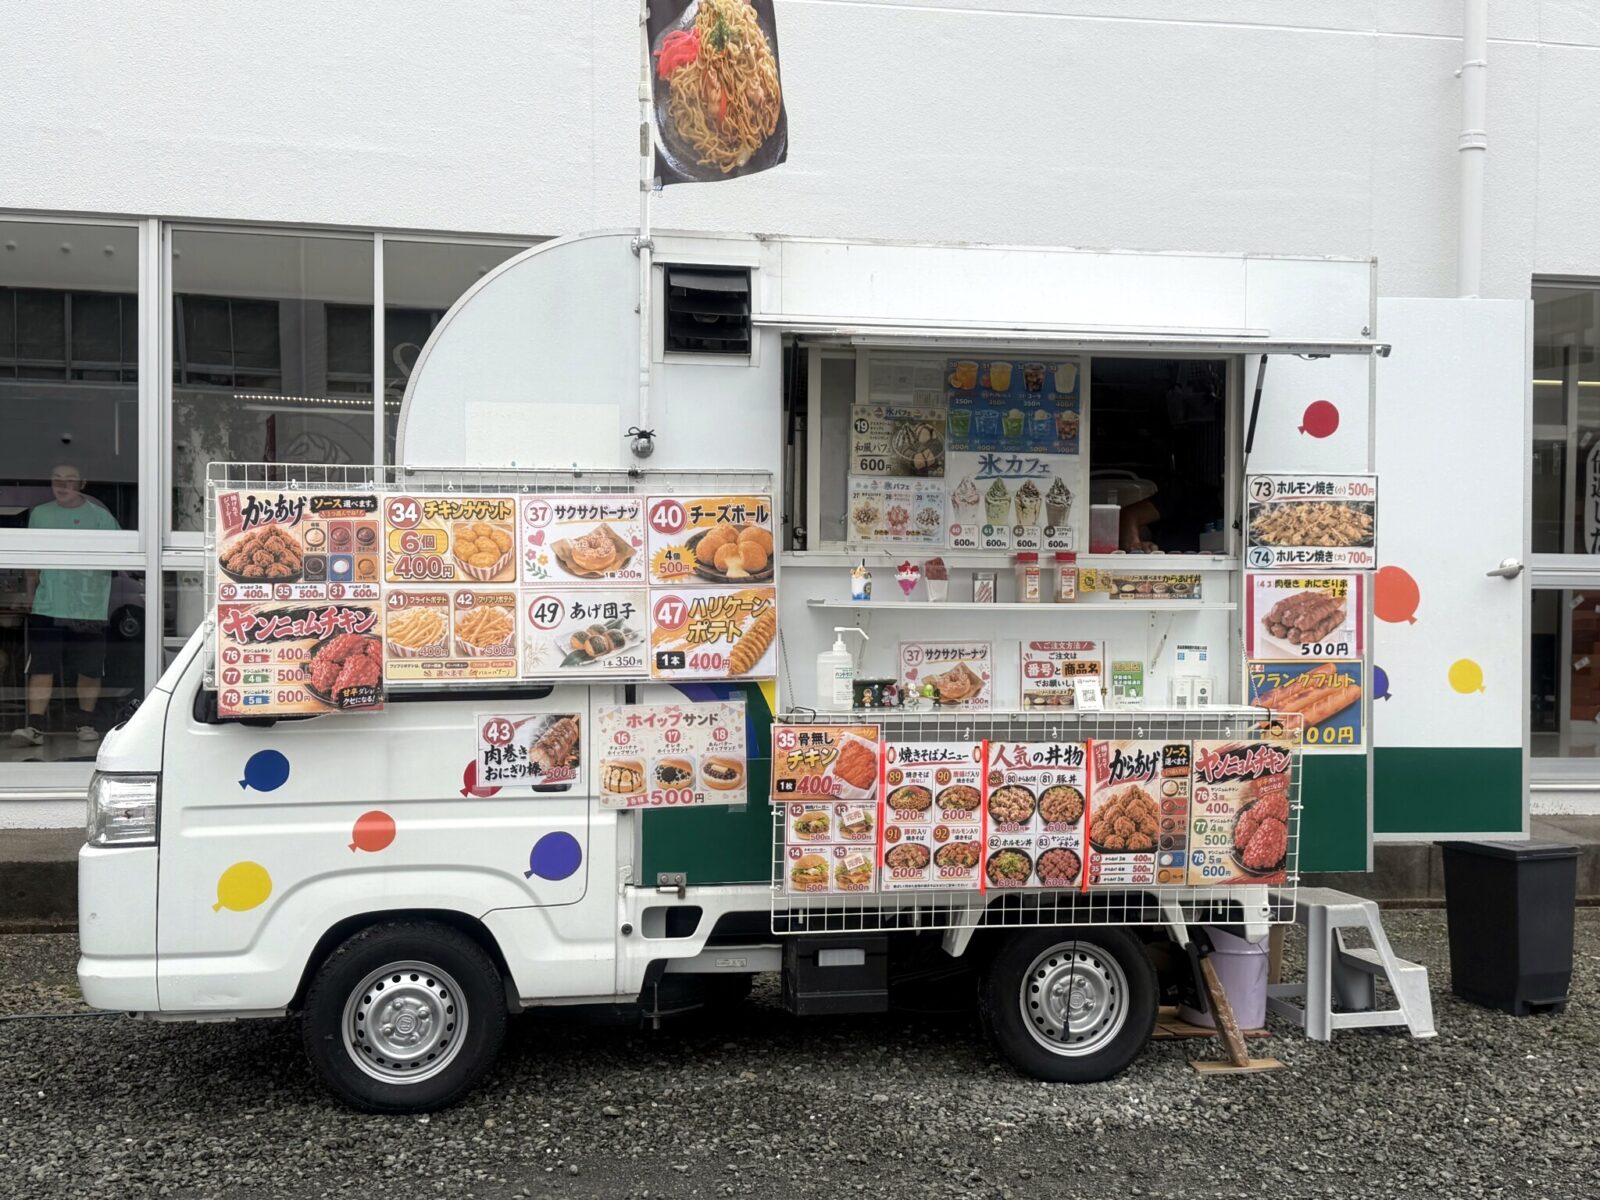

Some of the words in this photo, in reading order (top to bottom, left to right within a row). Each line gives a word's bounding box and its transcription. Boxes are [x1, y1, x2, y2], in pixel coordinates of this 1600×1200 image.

[855, 420, 868, 431] 19
[854, 441, 892, 453] 和風パフェ
[860, 458, 892, 472] 600円
[978, 453, 1050, 475] 氷カフェ
[1254, 482, 1272, 497] 73
[1277, 481, 1346, 495] ホルモン焼き(小)
[1348, 483, 1375, 496] 500円
[241, 494, 308, 531] からあげ
[391, 502, 418, 523] 34
[423, 500, 512, 520] チキンナゲット
[529, 506, 548, 521] 37
[555, 505, 639, 520] サクサクドーナツ
[652, 505, 682, 528] 40
[690, 504, 769, 524] チーズボール
[400, 530, 437, 554] 6個
[954, 539, 975, 547] 600円
[986, 539, 1006, 547] 600円
[1017, 540, 1037, 548] 600円
[1048, 540, 1068, 548] 600円
[664, 550, 681, 561] 4個
[1254, 551, 1271, 564] 74
[1276, 550, 1346, 563] ホルモン焼き(大)
[1347, 551, 1373, 564] 700円
[394, 556, 455, 579] 400円
[659, 561, 690, 573] 500円
[617, 570, 642, 579] 300円
[1275, 579, 1300, 588] 肉巻き
[222, 586, 236, 597] 30
[243, 589, 269, 598] 400円
[275, 586, 290, 597] 35
[300, 589, 325, 598] 500円
[331, 586, 344, 596] 31
[352, 588, 378, 598] 600円
[1332, 588, 1347, 597] 1本
[389, 594, 405, 606] 41
[456, 593, 473, 605] 42
[534, 602, 560, 623] 49
[570, 602, 637, 620] あげ団子
[657, 602, 684, 624] 47
[687, 596, 772, 619] ハリケーン
[223, 606, 377, 644] ヤンニョムチキン
[686, 618, 743, 644] ポテト
[225, 650, 238, 660] 76
[277, 648, 311, 660] 400円
[420, 646, 449, 657] 400円
[484, 645, 514, 657] 500円
[906, 650, 920, 661] 37
[925, 648, 987, 660] サクサクドーナツ
[1301, 643, 1348, 656] 500円
[615, 656, 643, 667] 350円
[661, 654, 680, 667] 1本
[688, 653, 731, 670] 400円
[1048, 652, 1078, 660] ご注文は
[1027, 662, 1099, 677] 番号と商品名
[225, 671, 238, 681] 77
[277, 670, 311, 682] 500円
[1251, 673, 1356, 688] フランクフルト
[1034, 679, 1075, 688] でお願いし
[225, 693, 238, 703] 78
[277, 691, 311, 703] 600円
[626, 712, 719, 729] ホイップサンド
[487, 722, 511, 742] 43
[666, 731, 679, 741] 17
[714, 729, 727, 739] 18
[615, 733, 628, 743] 16
[778, 732, 796, 747] 35
[798, 731, 834, 746] 骨無し
[484, 744, 528, 765] 肉巻き
[898, 746, 969, 763] 焼きそばメニュー
[991, 744, 1085, 768] 人気の丼物
[1165, 746, 1188, 757] ソース
[787, 747, 839, 772] チキン
[1194, 745, 1292, 783] ヤンニョムチキン
[485, 761, 543, 781] おにぎり棒
[1109, 748, 1161, 786] からあげ
[889, 771, 901, 782] 89
[937, 771, 949, 782] 90
[1007, 775, 1016, 783] 80
[1042, 775, 1051, 783] 81
[1055, 774, 1078, 783] 豚丼
[780, 781, 793, 790] 1枚
[796, 775, 842, 795] 400円
[651, 789, 705, 805] 500円
[1196, 791, 1208, 799] 76
[791, 806, 802, 814] 12
[837, 806, 848, 814] 13
[1205, 803, 1235, 814] 400円
[895, 809, 925, 820] 500円
[942, 809, 973, 820] 600円
[1195, 822, 1207, 832] 77
[810, 833, 830, 841] 500円
[887, 829, 899, 840] 91
[935, 828, 947, 839] 92
[989, 838, 999, 847] 82
[1002, 838, 1032, 847] ホルモン丼
[1038, 838, 1048, 846] 83
[1204, 835, 1234, 846] 500円
[789, 849, 800, 857] 14
[834, 848, 845, 856] 15
[1194, 854, 1205, 863] 78
[892, 867, 923, 878] 600円
[940, 866, 971, 877] 600円
[1202, 866, 1231, 877] 600円
[806, 884, 828, 892] 500円
[847, 883, 870, 891] 600円
